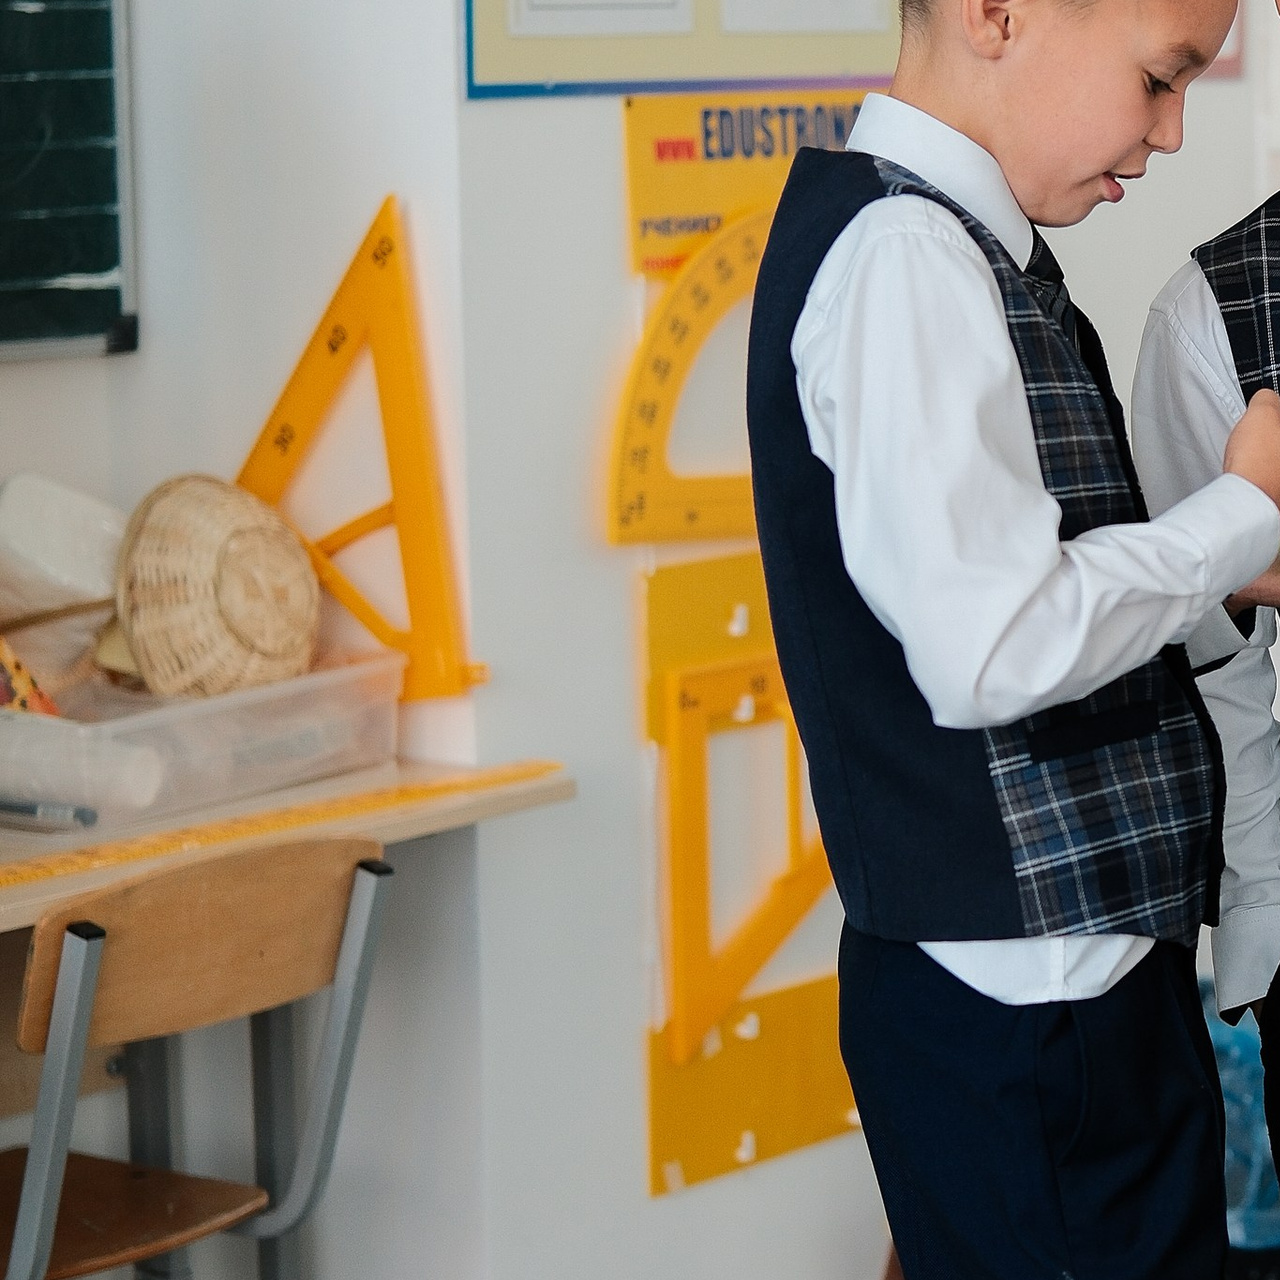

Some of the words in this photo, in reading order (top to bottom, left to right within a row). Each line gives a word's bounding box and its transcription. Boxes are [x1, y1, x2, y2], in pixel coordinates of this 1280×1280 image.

[702, 102, 863, 159] EDUSTRON
[372, 234, 394, 268] 50
[326, 323, 347, 355] 40
